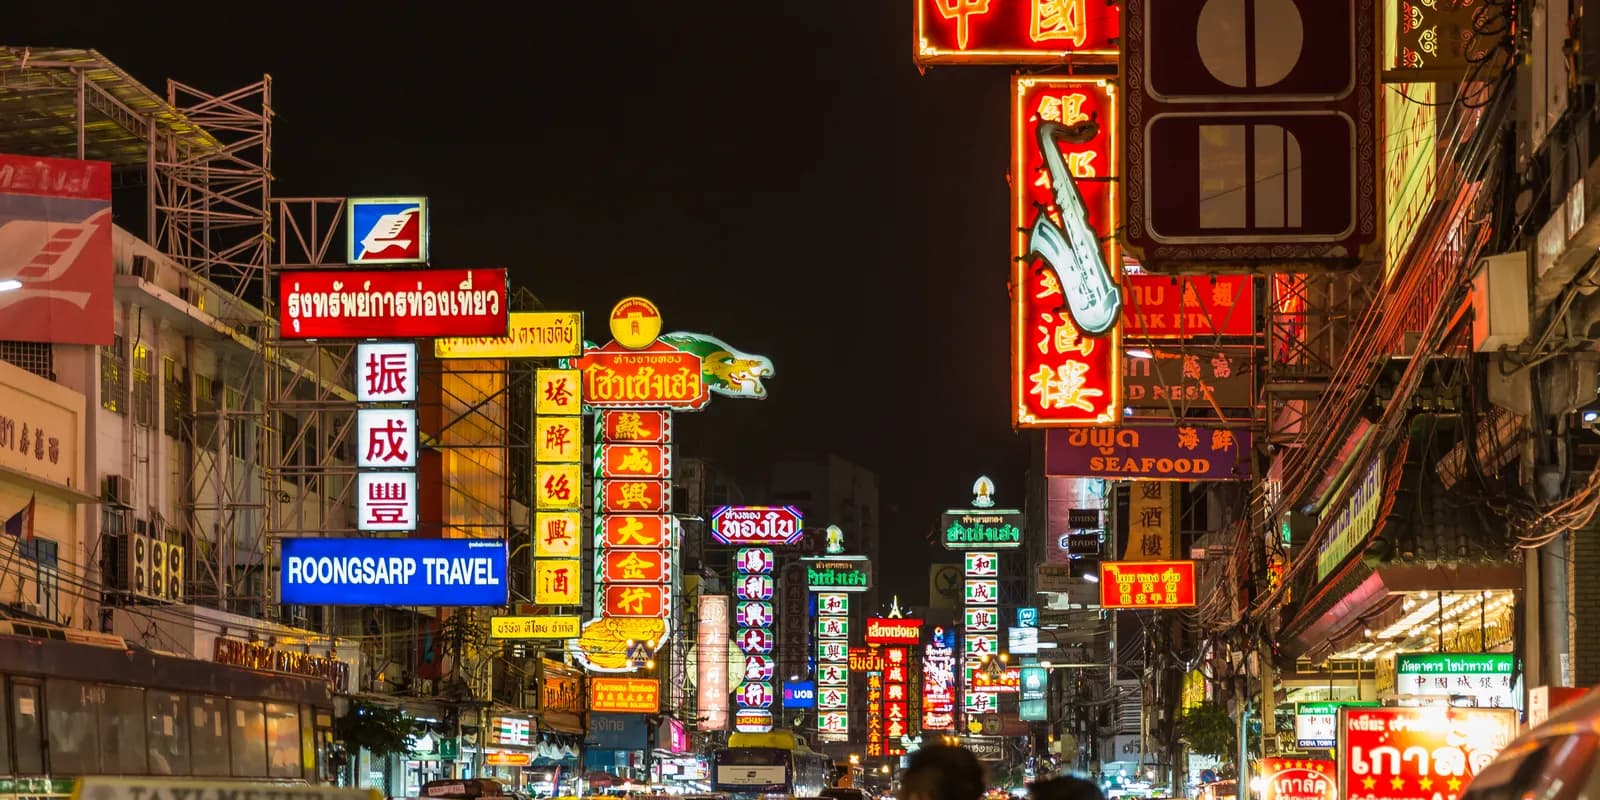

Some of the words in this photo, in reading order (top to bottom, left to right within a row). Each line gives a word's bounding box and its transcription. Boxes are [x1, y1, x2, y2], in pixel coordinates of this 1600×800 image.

[288, 271, 499, 332] รุ่งทรัพย์การท่องเที่ยว
[1174, 313, 1213, 329] FIN
[1152, 385, 1215, 401] NEST
[365, 353, 408, 524] 振成豐
[1178, 427, 1233, 452] 海鮮
[1090, 457, 1210, 473] SEAFOOD
[614, 412, 656, 615] 蘇成興大金行
[1071, 539, 1097, 547] RADO
[288, 556, 416, 585] ROONGSARP
[423, 556, 499, 585] TRAVEL
[973, 557, 990, 710] 和成興大行
[794, 690, 814, 699] UOB
